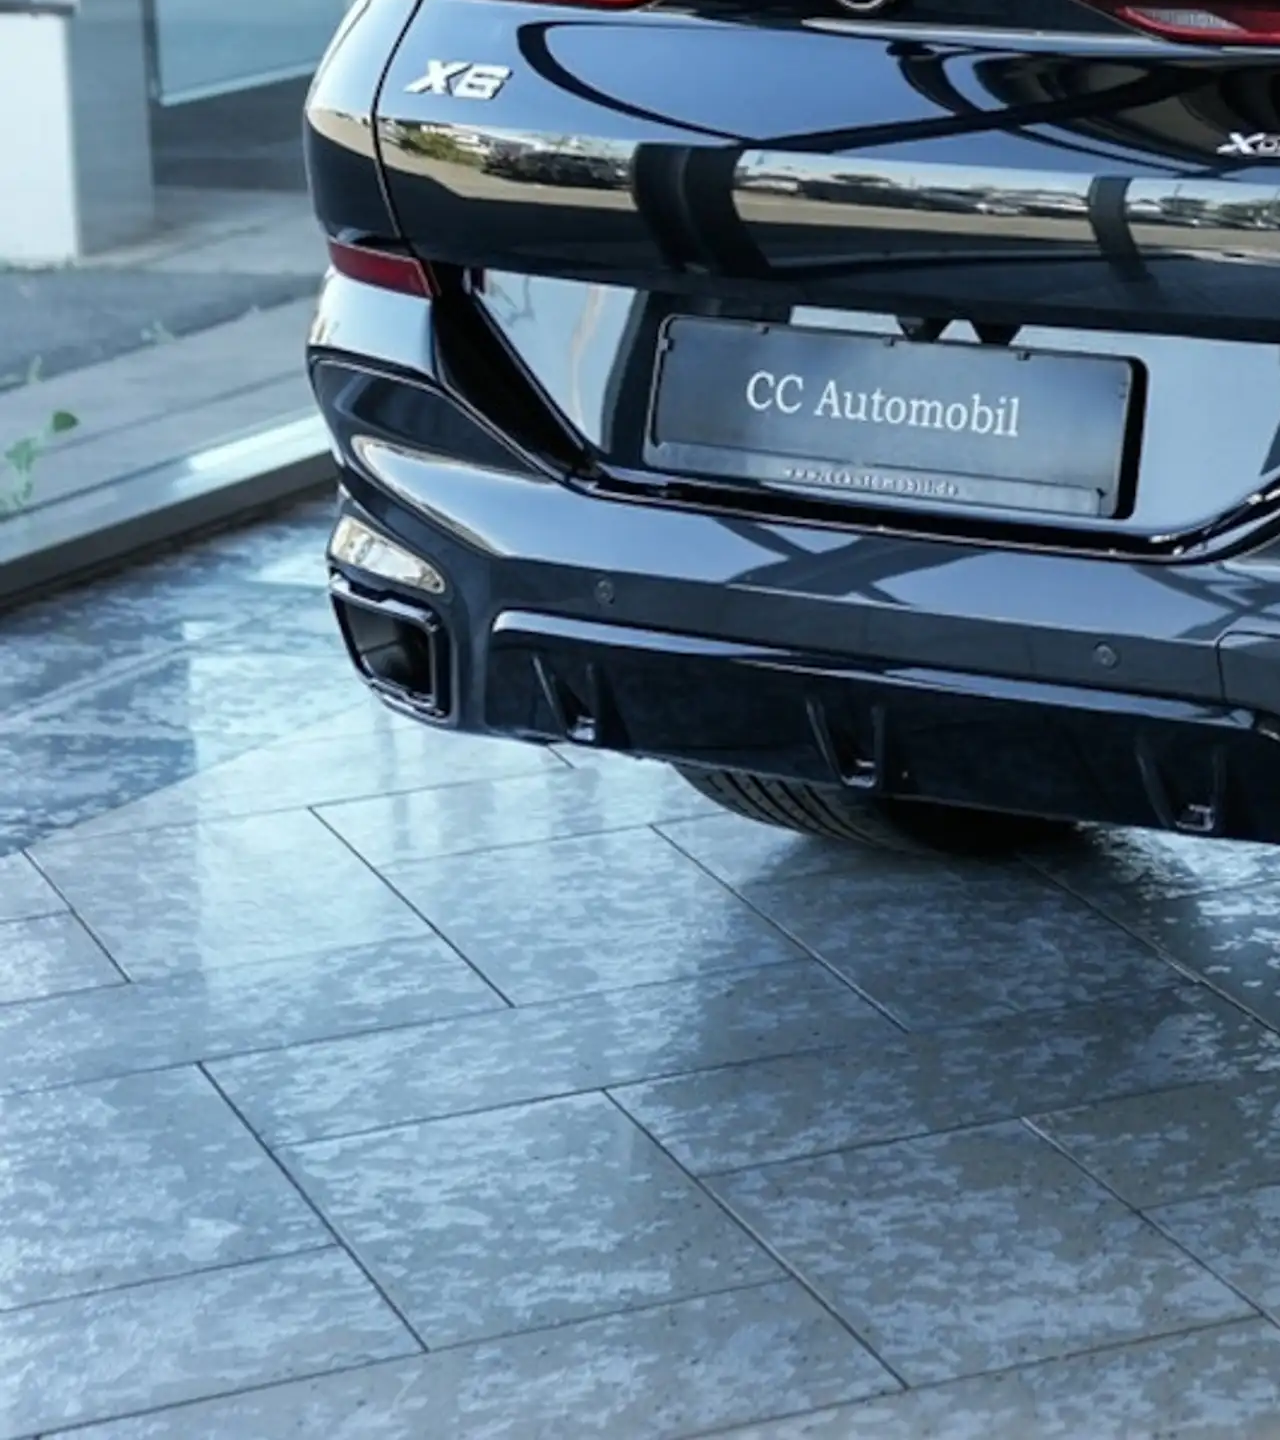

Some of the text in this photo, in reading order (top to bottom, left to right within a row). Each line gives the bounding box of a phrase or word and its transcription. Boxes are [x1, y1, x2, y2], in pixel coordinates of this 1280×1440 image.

[403, 59, 512, 100] X6
[746, 370, 1021, 437] CC Automobil
